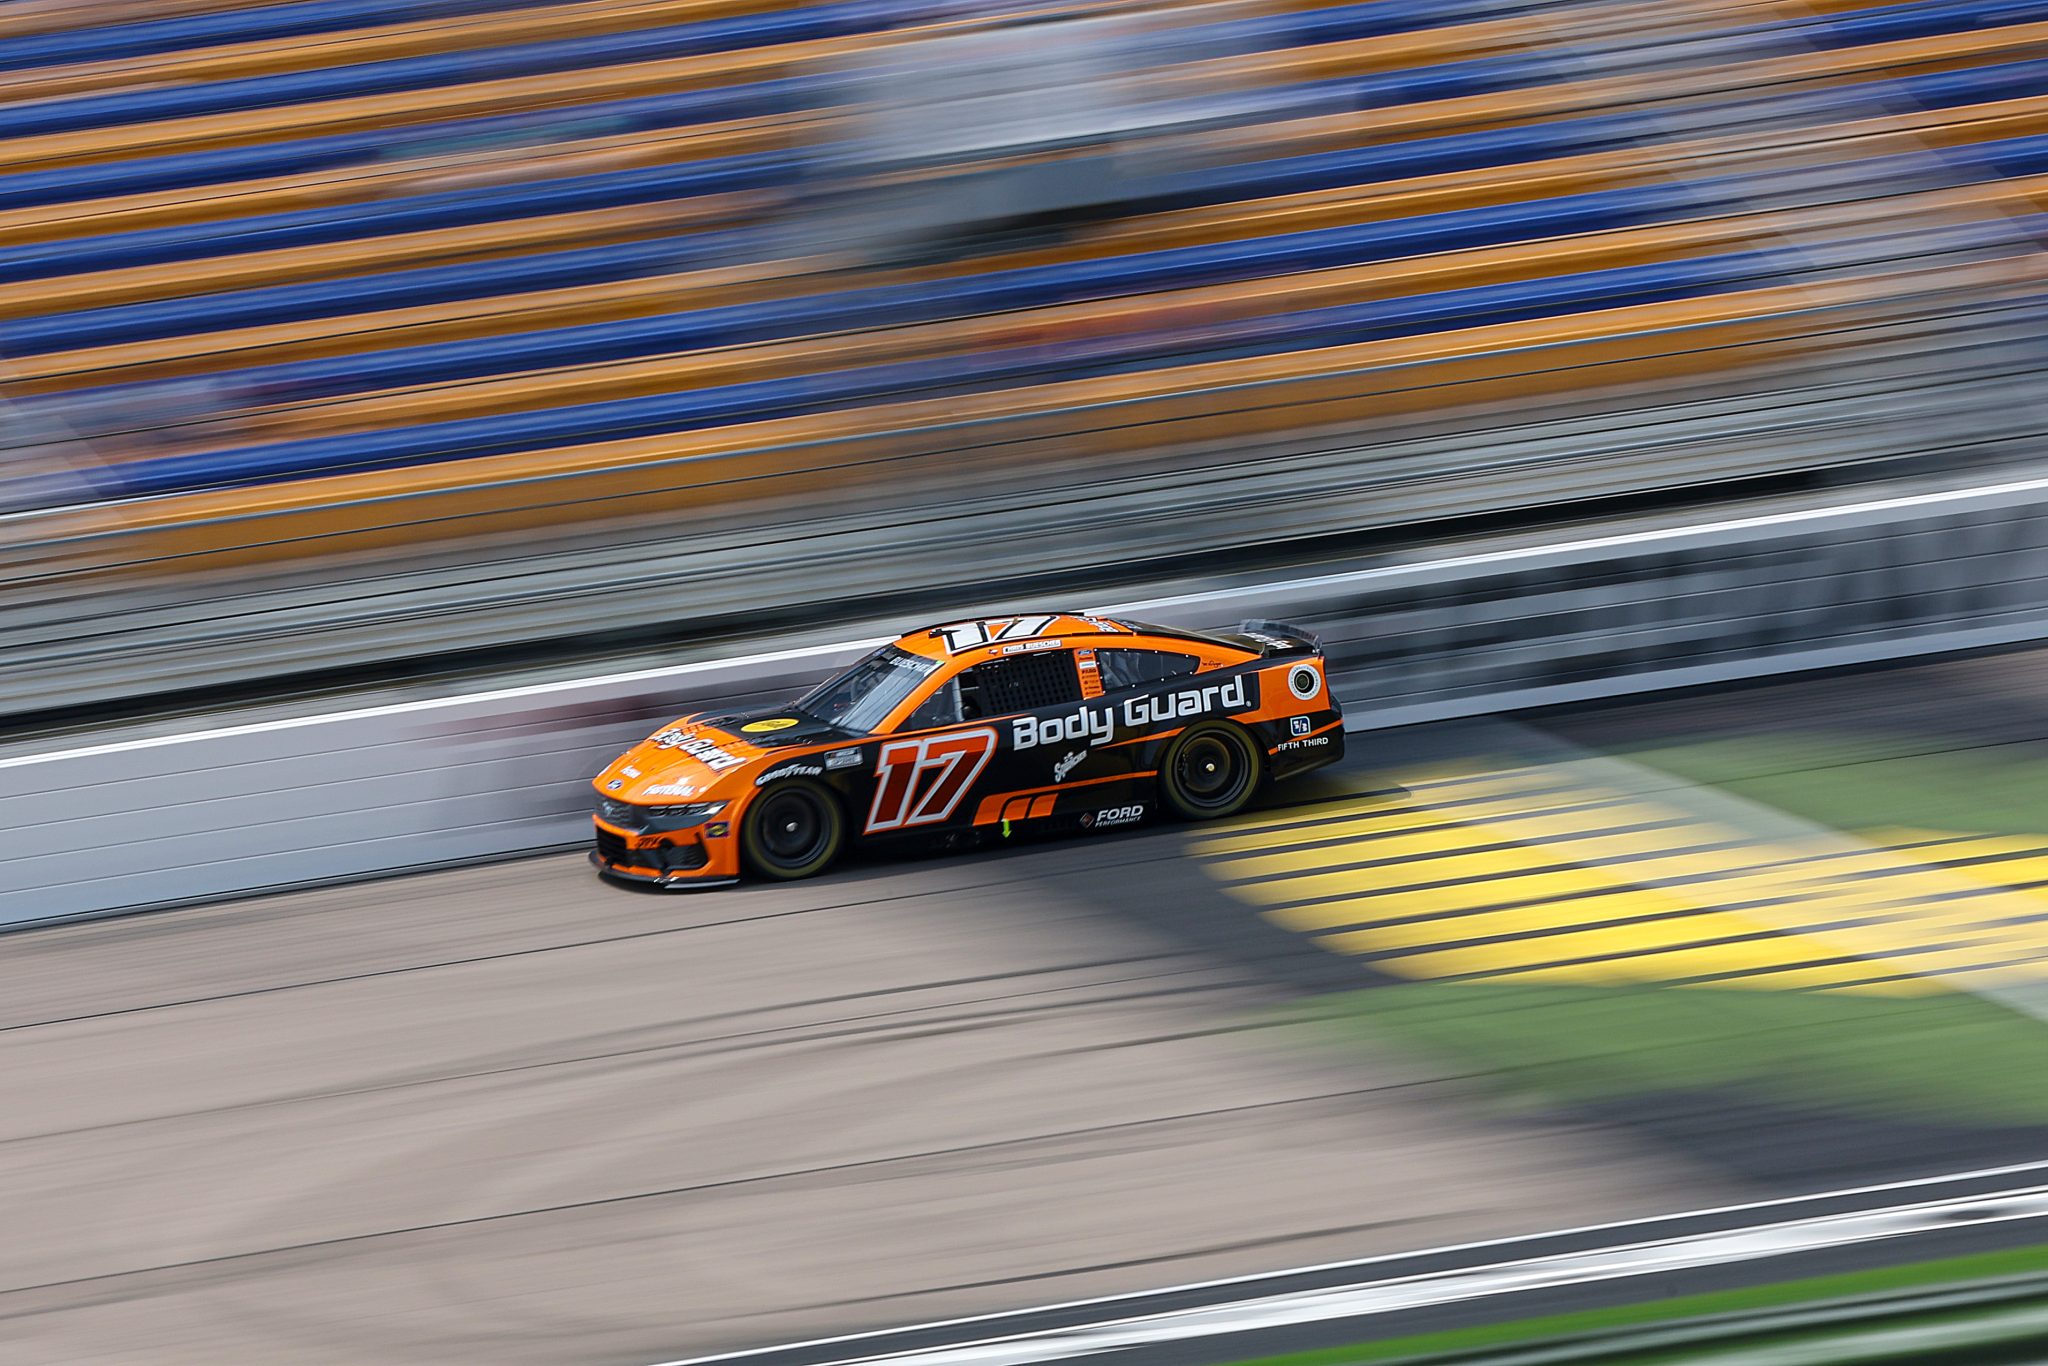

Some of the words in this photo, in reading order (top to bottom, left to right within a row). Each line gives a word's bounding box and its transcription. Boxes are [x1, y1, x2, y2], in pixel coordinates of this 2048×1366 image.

[930, 615, 1060, 655] 17
[1012, 706, 1114, 751] Body
[1123, 674, 1245, 728] Guard
[1277, 740, 1300, 752] FIFTH
[1302, 737, 1329, 748] THIRD
[754, 763, 823, 786] GOODYEAR
[863, 727, 999, 835] 17
[1094, 815, 1142, 828] PERFORMANCE
[1096, 805, 1145, 823] FORD
